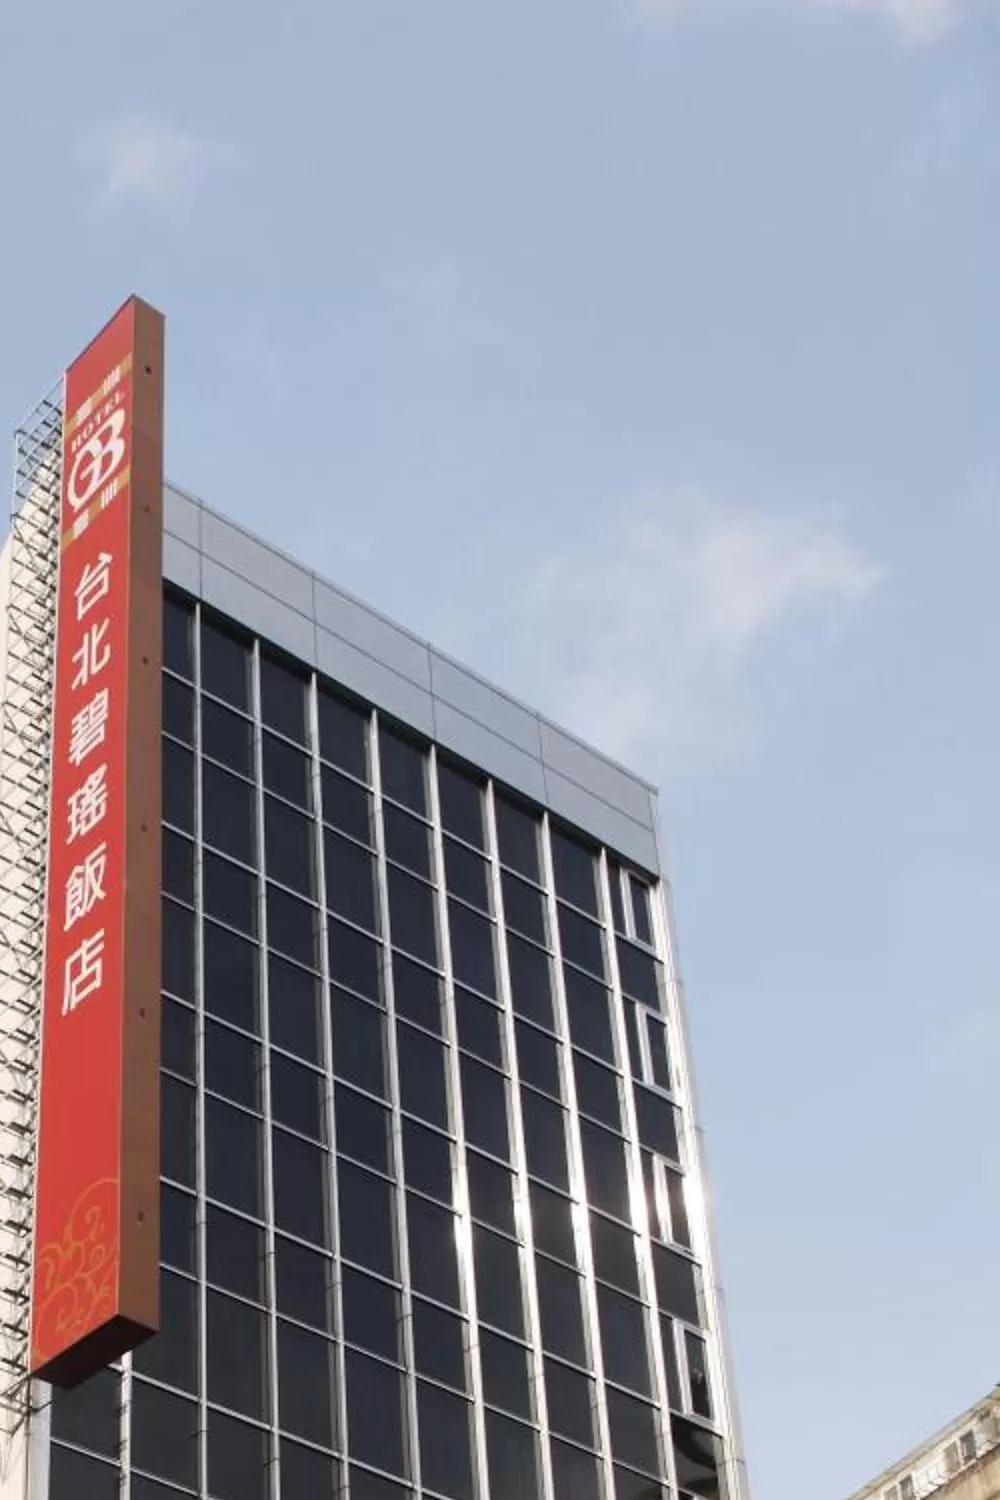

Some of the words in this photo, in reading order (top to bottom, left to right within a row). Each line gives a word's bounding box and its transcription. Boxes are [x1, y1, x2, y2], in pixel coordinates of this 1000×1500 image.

[71, 391, 125, 452] HOTEL
[61, 552, 114, 1017] 台北碧瑤飯店
